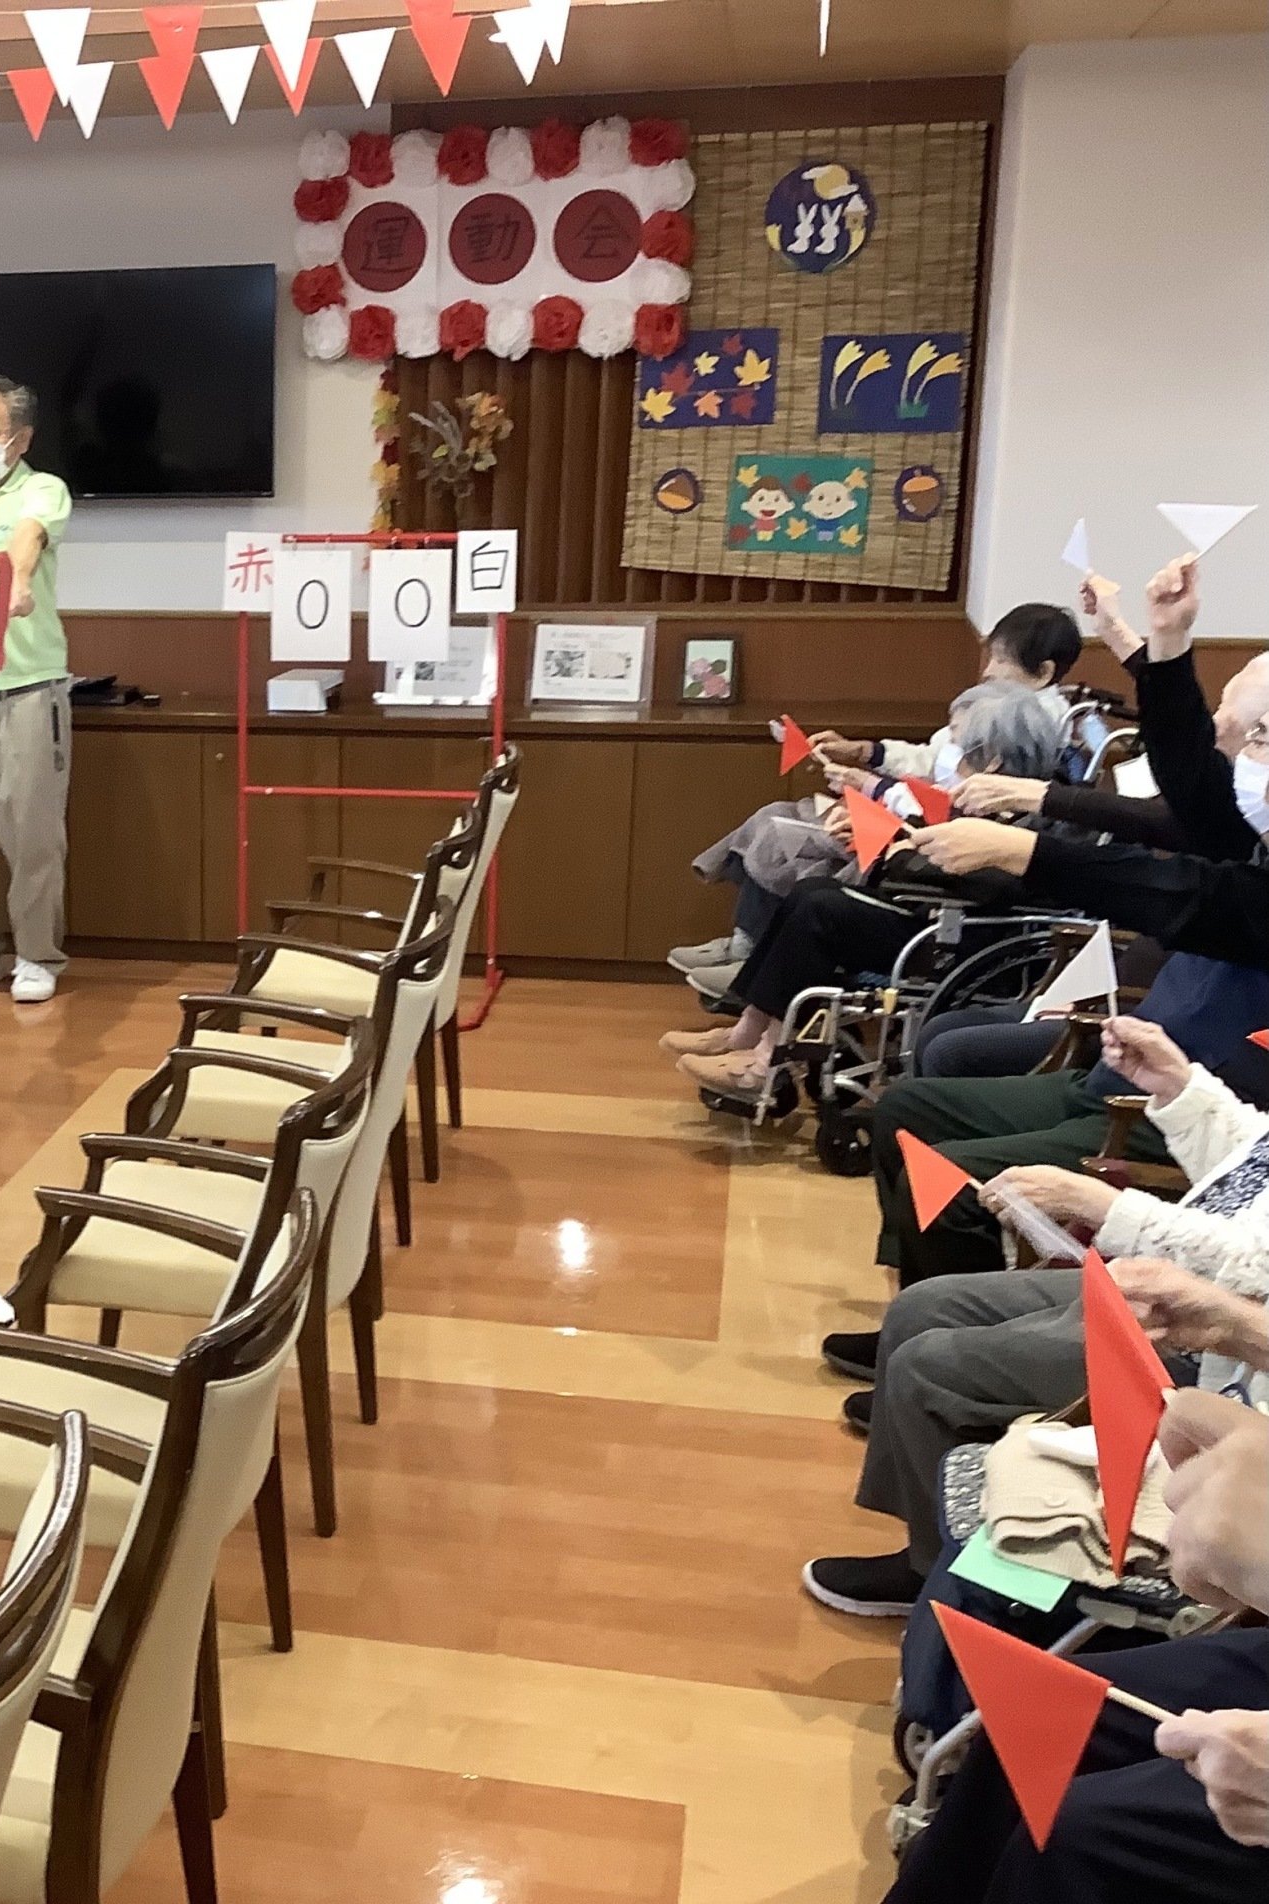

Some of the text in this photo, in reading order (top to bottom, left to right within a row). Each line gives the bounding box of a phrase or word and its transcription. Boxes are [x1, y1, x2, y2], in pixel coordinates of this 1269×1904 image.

[360, 203, 632, 274] 運動会
[229, 543, 275, 592] 赤
[471, 541, 509, 591] 白
[297, 579, 329, 629] 0
[395, 578, 431, 628] 0
